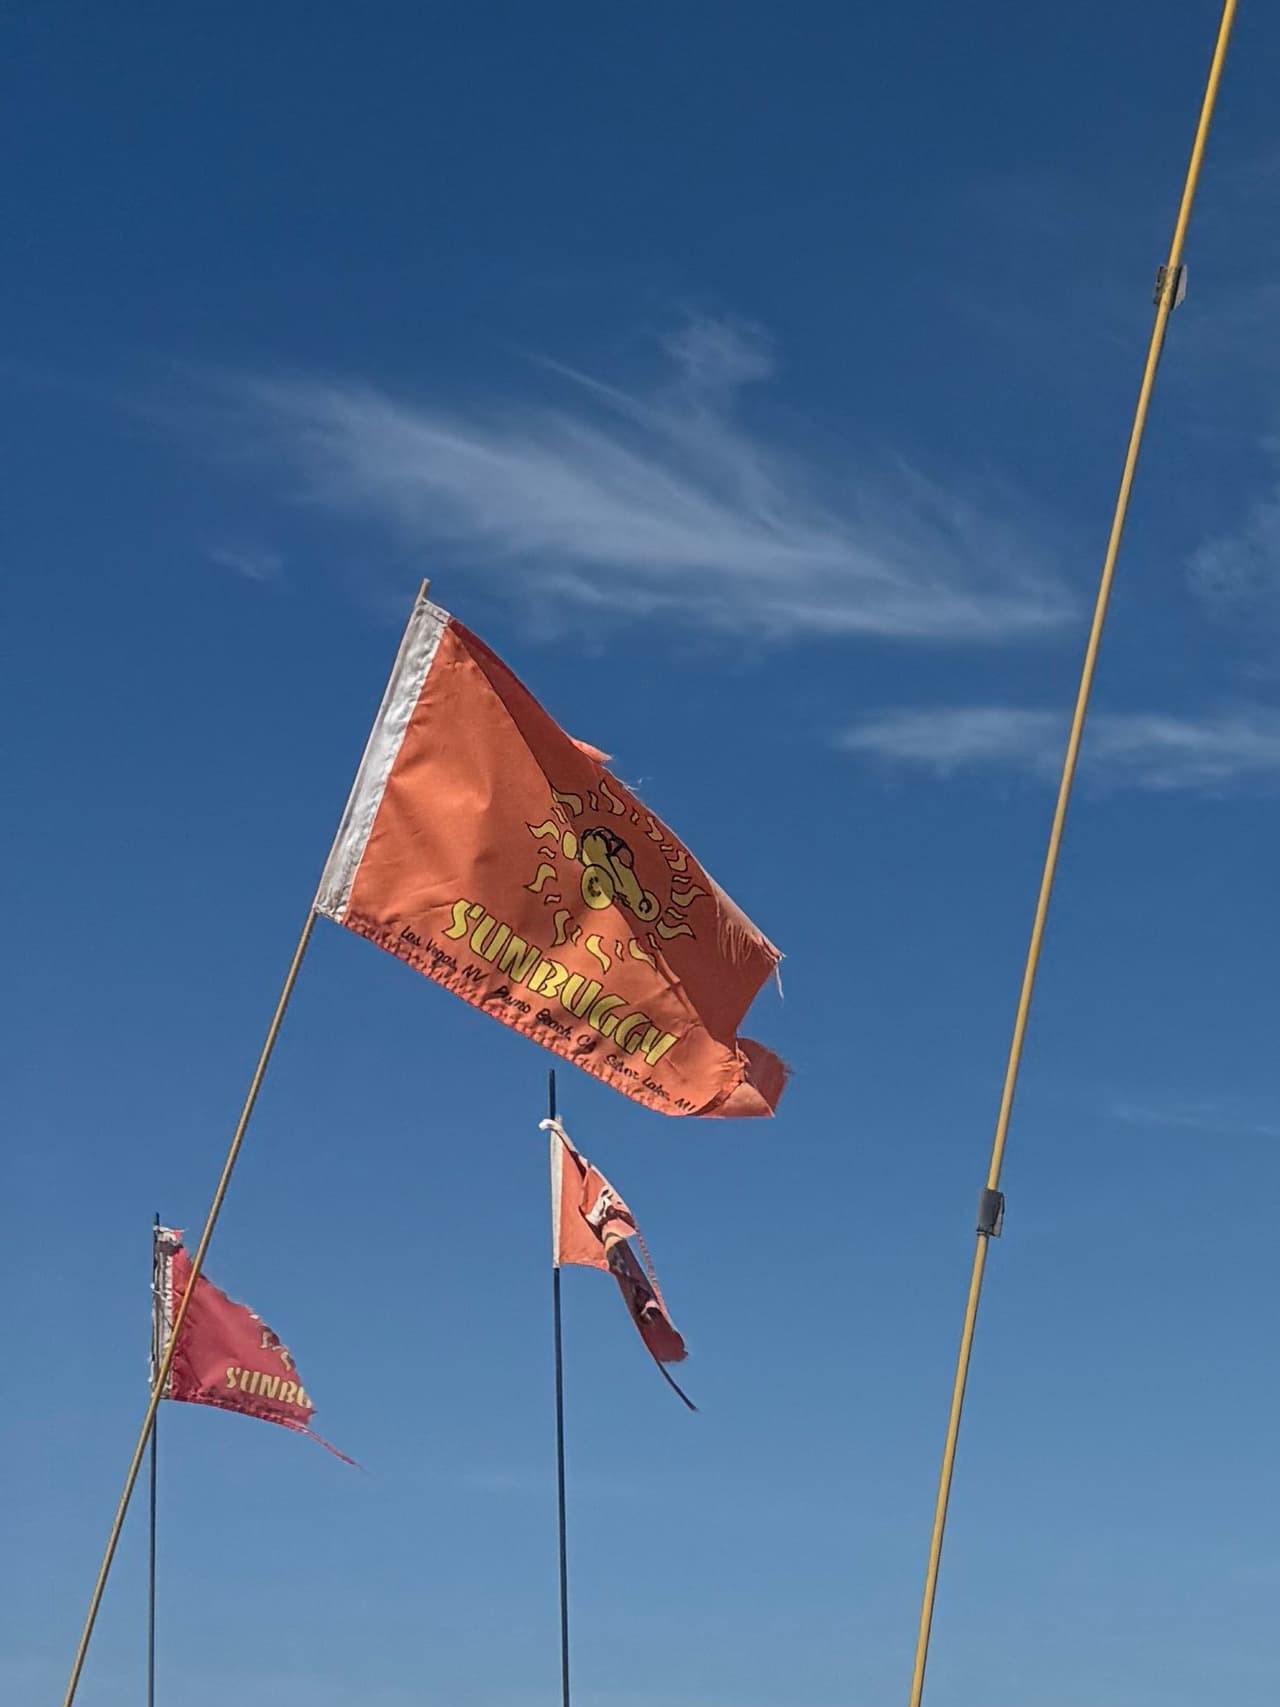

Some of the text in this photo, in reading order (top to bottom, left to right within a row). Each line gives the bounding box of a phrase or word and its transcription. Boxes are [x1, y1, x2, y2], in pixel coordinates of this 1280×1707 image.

[401, 926, 421, 948] Las
[462, 964, 487, 983] NV
[577, 1034, 597, 1055] CA
[443, 899, 679, 1066] SUNBUGGY
